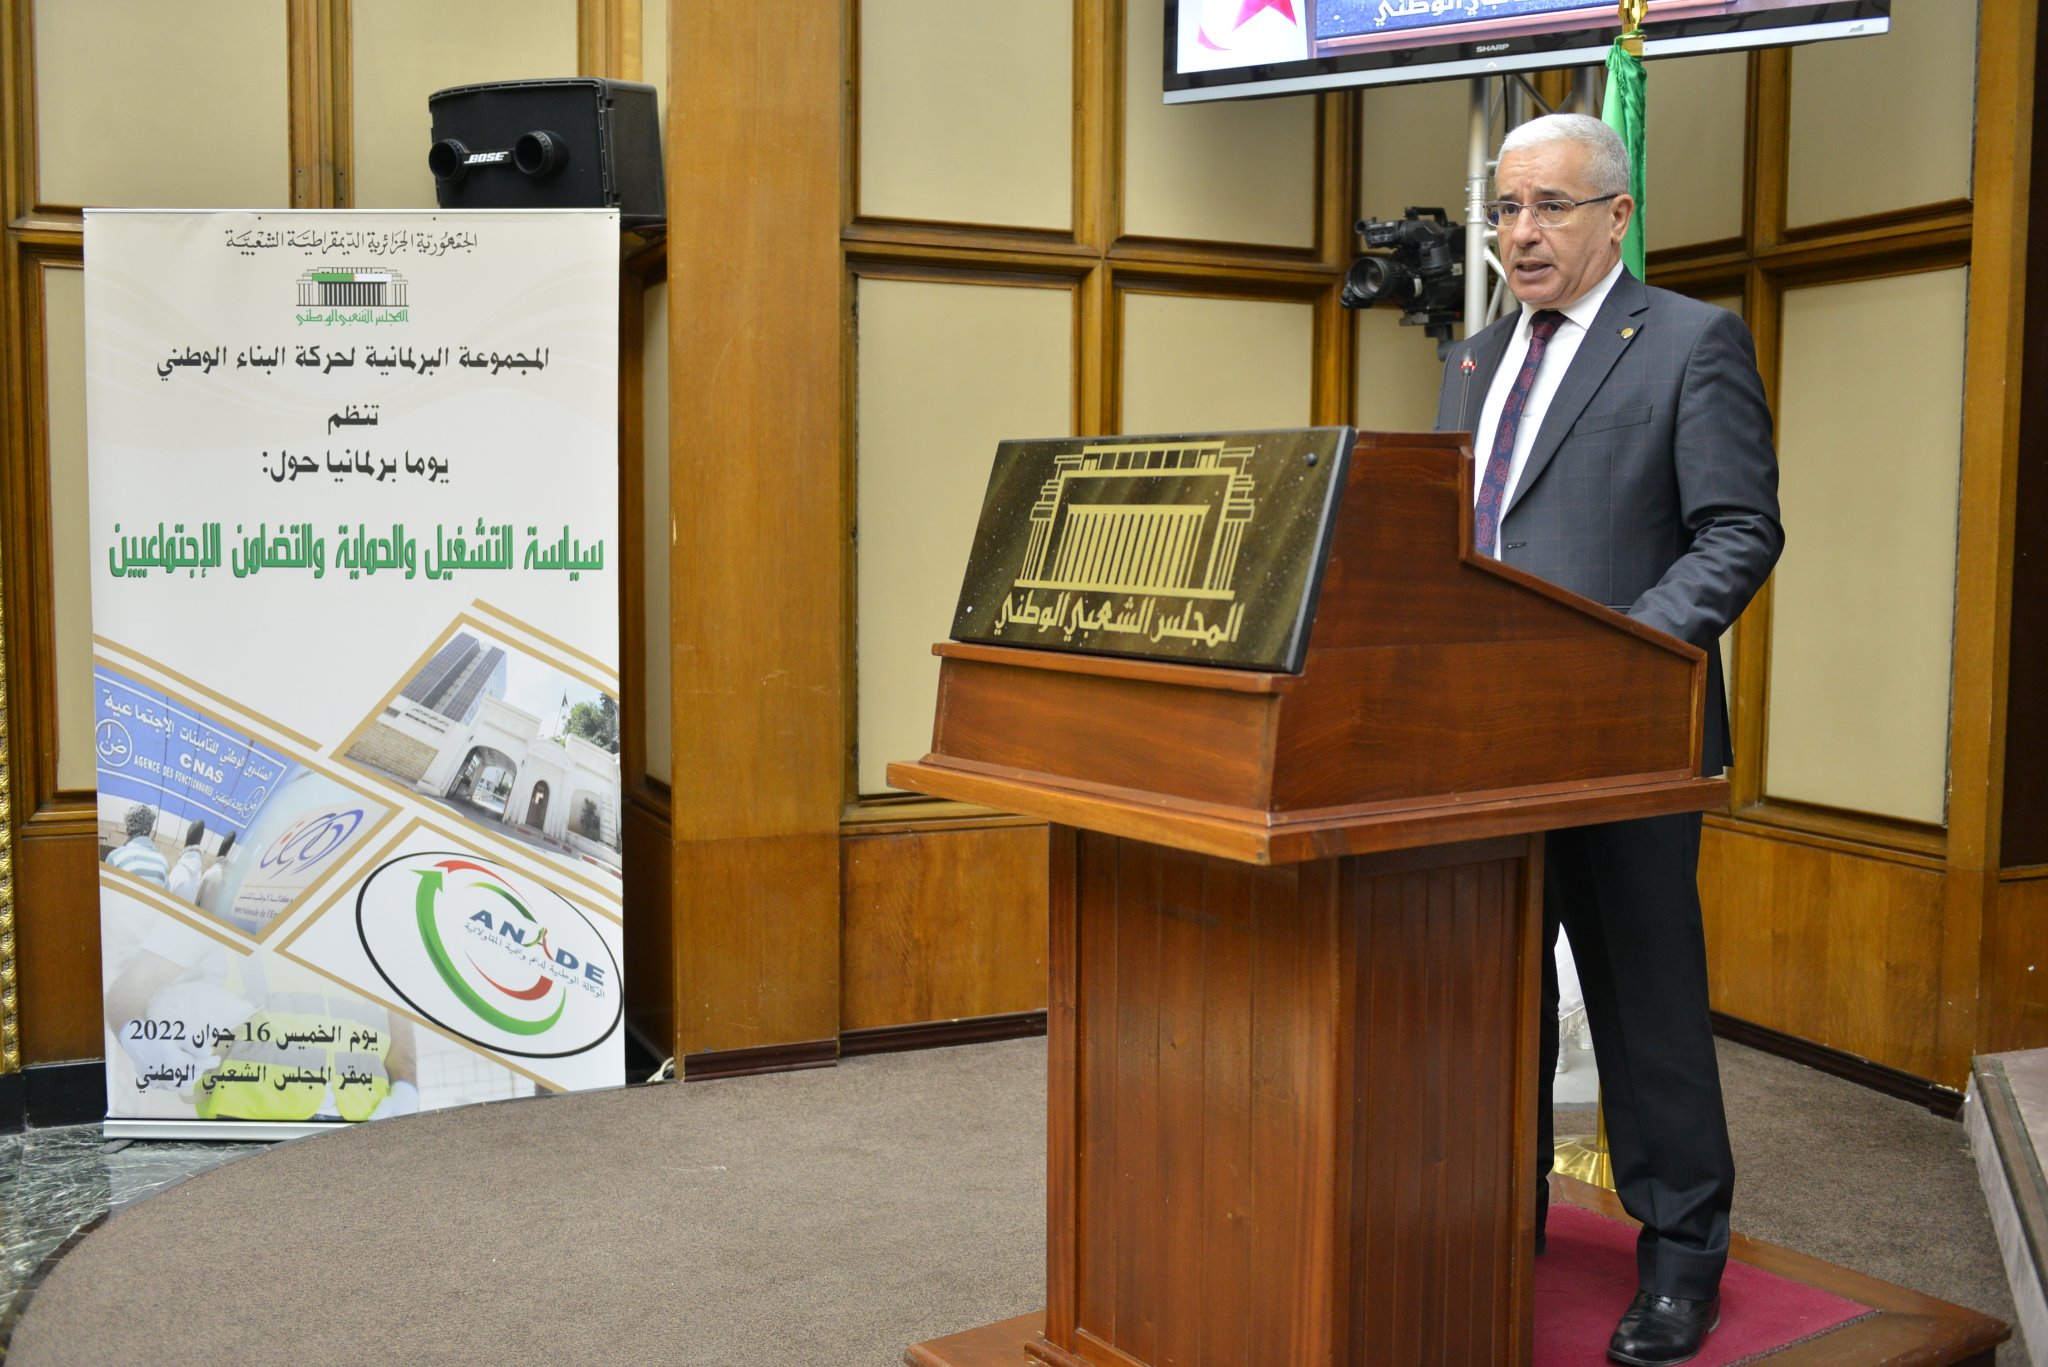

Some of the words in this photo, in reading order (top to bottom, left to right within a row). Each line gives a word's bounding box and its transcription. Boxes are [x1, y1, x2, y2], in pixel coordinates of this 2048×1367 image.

[1476, 43, 1510, 53] SHARP
[464, 151, 509, 165] BOSE
[157, 346, 227, 381] الوطني
[236, 345, 285, 375] البناء
[294, 345, 355, 375] لحركة
[365, 345, 449, 376] البرلمانية
[458, 345, 549, 376] المجموعة
[327, 404, 379, 435] تنظم
[262, 450, 320, 483] حول:
[326, 449, 397, 483] برلمانيا
[405, 450, 449, 484] يوما
[109, 522, 222, 578] الإجتماعيين
[232, 523, 324, 578] والتضامن
[336, 523, 416, 580] والحماية
[424, 517, 513, 580] التشغيل
[524, 525, 604, 581] سياسة
[994, 589, 1070, 636] الوطني
[1064, 597, 1156, 642] الشعبي
[1150, 600, 1246, 647] المجلس
[134, 755, 160, 773] AGENCE
[163, 765, 174, 778] DES
[180, 753, 223, 784] CNAS
[219, 747, 245, 769] الوطني
[469, 909, 605, 987] ANADE
[129, 1019, 186, 1041] 2022
[192, 1023, 236, 1048] جوان
[243, 1021, 271, 1042] 16
[276, 1024, 341, 1050] الخميس
[349, 1029, 379, 1052] يوم
[136, 1063, 195, 1094] الوطني
[202, 1063, 266, 1094] الشعبي
[273, 1065, 331, 1090] المجلس
[339, 1065, 373, 1091] بمقر
